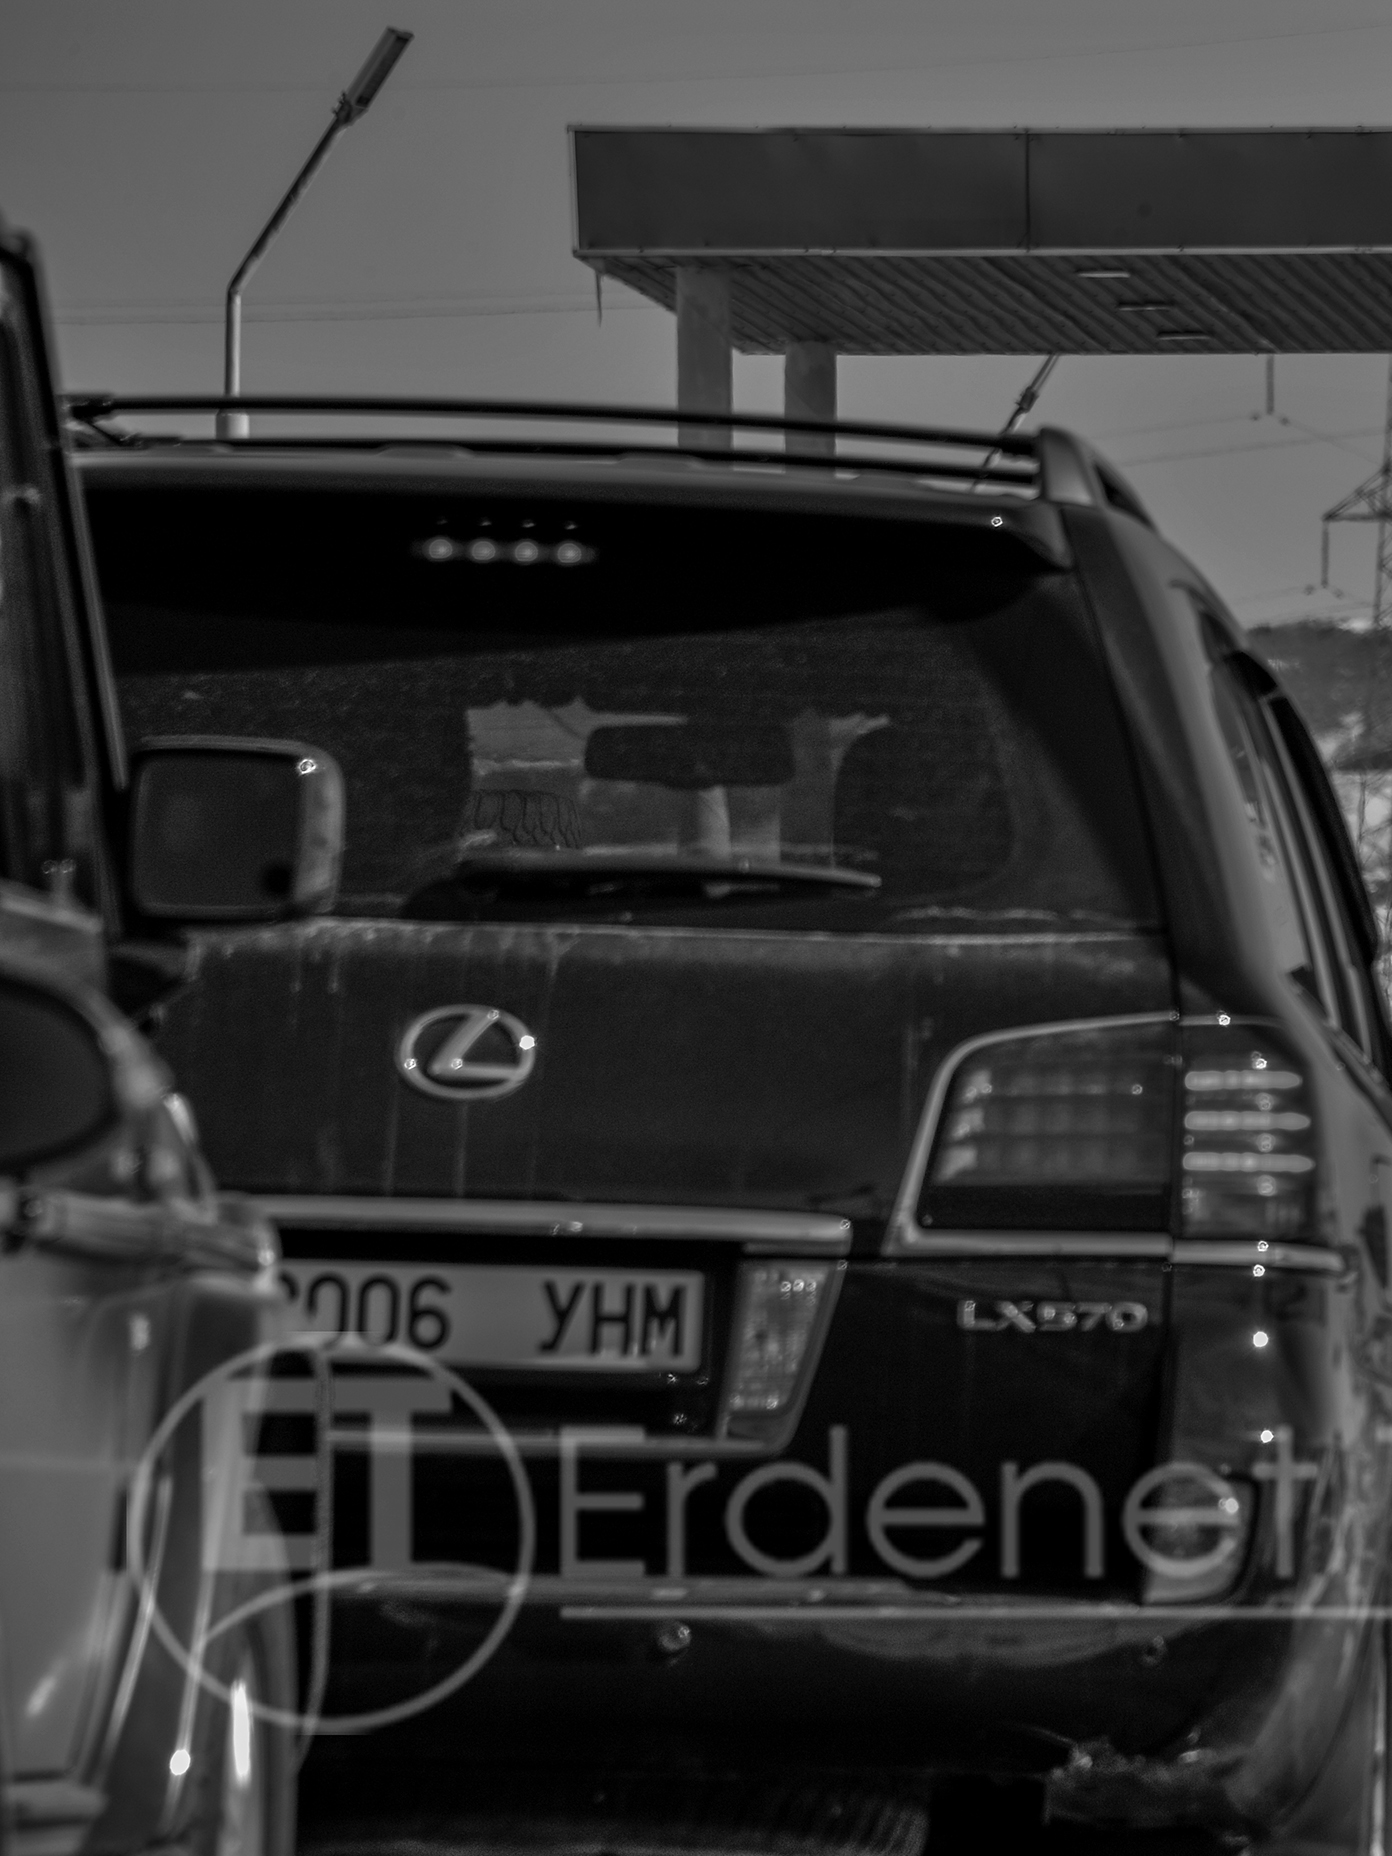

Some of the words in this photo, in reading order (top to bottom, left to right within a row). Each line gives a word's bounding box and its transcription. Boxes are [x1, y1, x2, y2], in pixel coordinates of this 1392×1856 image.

[280, 1271, 452, 1351] 006
[537, 1280, 688, 1358] УНМ
[956, 1299, 1149, 1334] LX570
